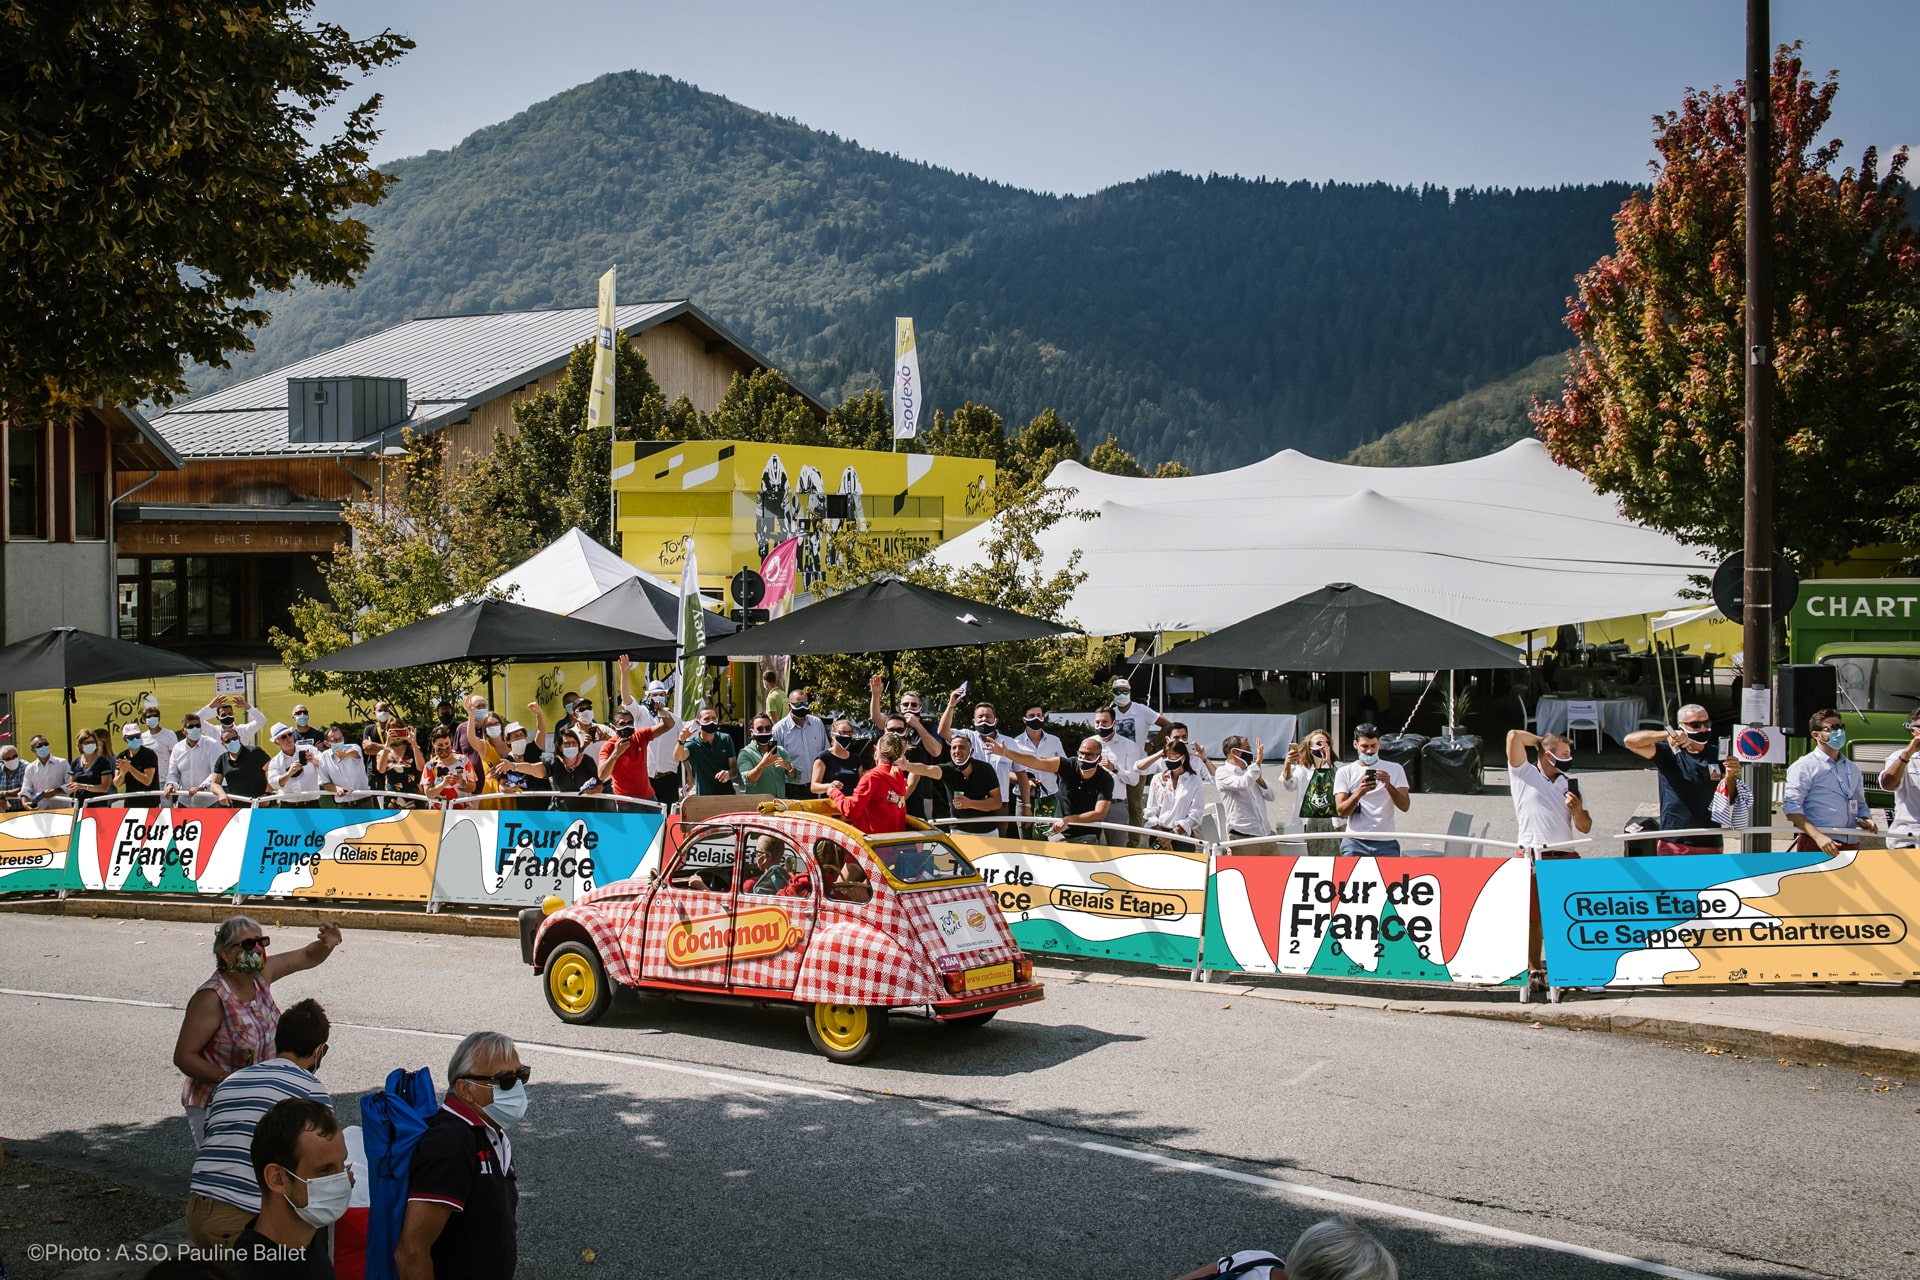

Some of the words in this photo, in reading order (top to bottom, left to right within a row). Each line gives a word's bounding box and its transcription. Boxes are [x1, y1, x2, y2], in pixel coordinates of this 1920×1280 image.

[901, 365, 914, 431] sodexo
[1806, 596, 1918, 617] CHART
[124, 819, 169, 841] Tour
[172, 820, 199, 842] de
[266, 829, 302, 847] Tour
[303, 829, 325, 848] de
[504, 823, 561, 849] Tour
[566, 825, 599, 850] de
[115, 841, 194, 867] France
[260, 847, 321, 868] France
[339, 847, 378, 862] Relais
[380, 844, 419, 864] Étape
[497, 849, 596, 879] France
[686, 846, 735, 866] Relais
[1004, 865, 1034, 888] de
[1294, 872, 1377, 905] Tour
[1386, 874, 1434, 906] de
[1058, 889, 1115, 911] Relais
[1119, 890, 1175, 917] Étape
[1576, 896, 1649, 916] Relais
[1655, 891, 1727, 918] Étape
[1290, 904, 1433, 943] France
[1579, 926, 1609, 945] Le
[1615, 925, 1706, 948] Sappey
[1712, 927, 1743, 943] en
[1750, 921, 1890, 942] Chartreuse
[673, 921, 780, 957] Cochonou
